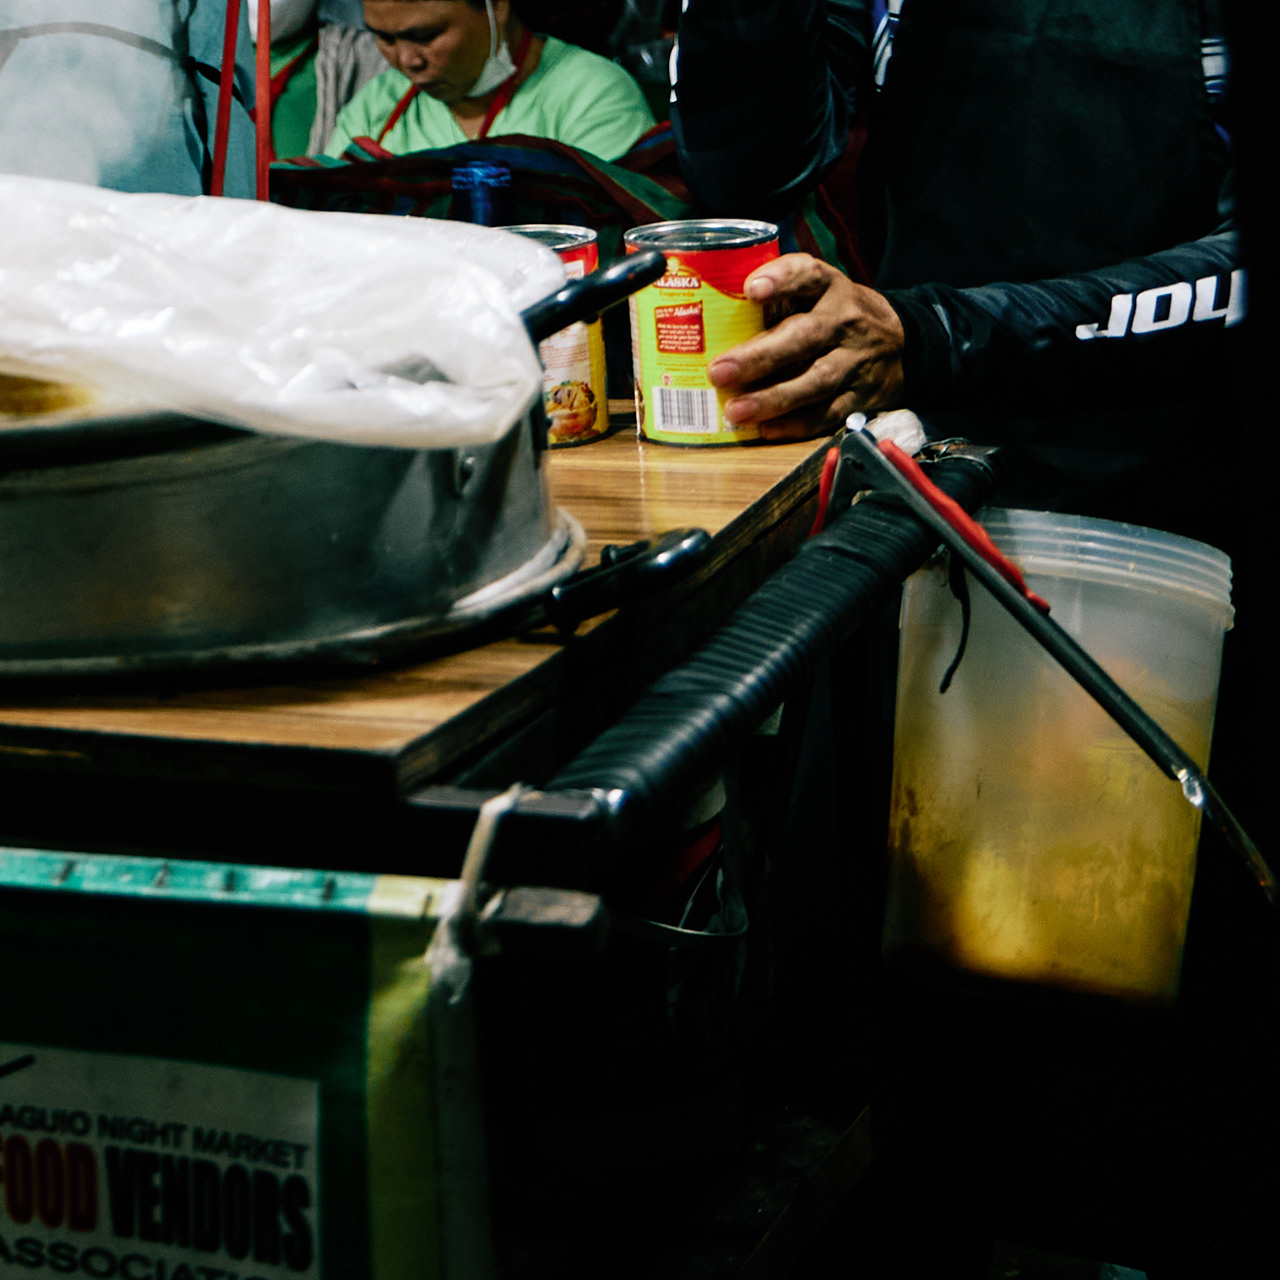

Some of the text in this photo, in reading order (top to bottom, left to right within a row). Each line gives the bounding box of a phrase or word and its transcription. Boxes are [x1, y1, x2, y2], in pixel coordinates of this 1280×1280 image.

[98, 1114, 187, 1149] NIGHT
[193, 1127, 309, 1169] MARKET
[105, 1146, 312, 1272] VENDORS
